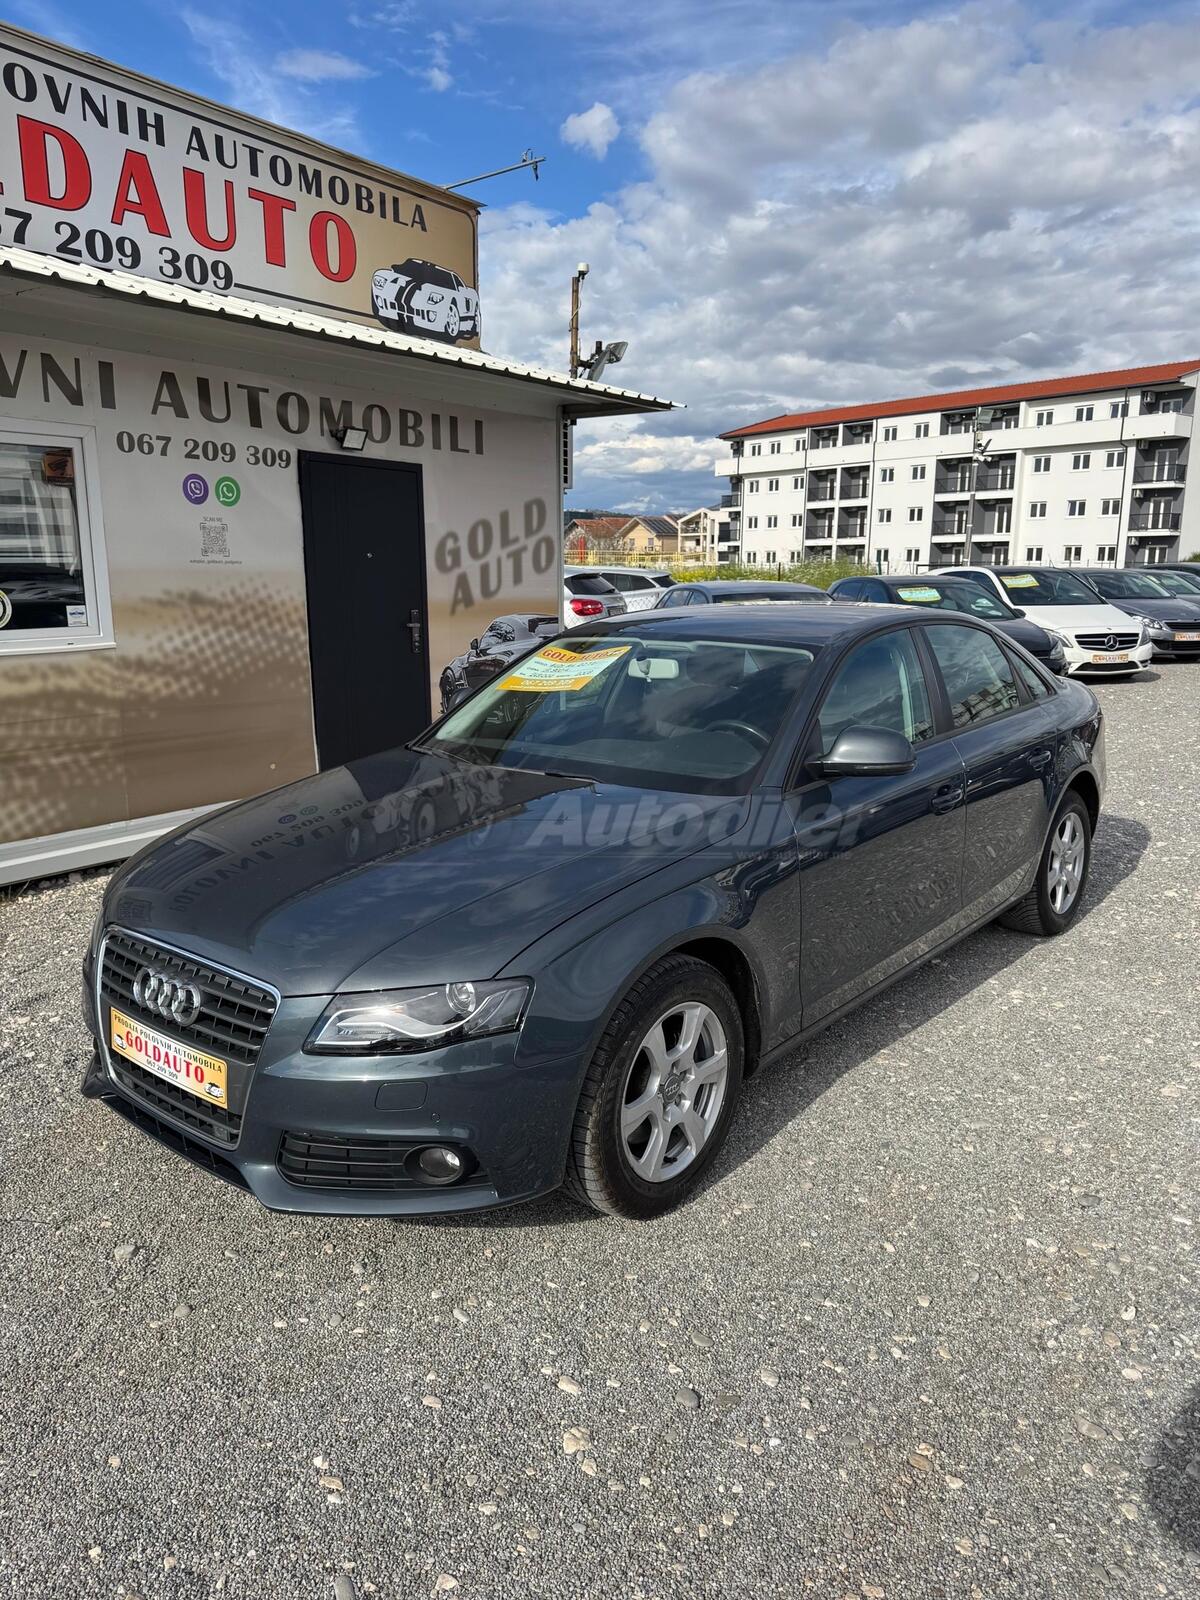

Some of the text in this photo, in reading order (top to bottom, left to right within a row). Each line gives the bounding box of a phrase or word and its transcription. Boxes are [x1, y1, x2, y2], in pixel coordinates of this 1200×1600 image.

[3, 62, 429, 232] OVNIH AUTOMOBILA
[0, 113, 357, 283] DAUTO
[55, 221, 141, 269] 209
[159, 247, 234, 291] 309
[116, 430, 292, 469] 067 209 309
[151, 371, 484, 455] AUTOMOBILI
[435, 498, 547, 574] GOLD
[449, 534, 555, 617] AUTO
[542, 649, 577, 662] GOLD
[114, 1014, 222, 1073] PRODAJA POLOVNIH AUTOMOBILA
[126, 1030, 204, 1083] GOLDAUTO
